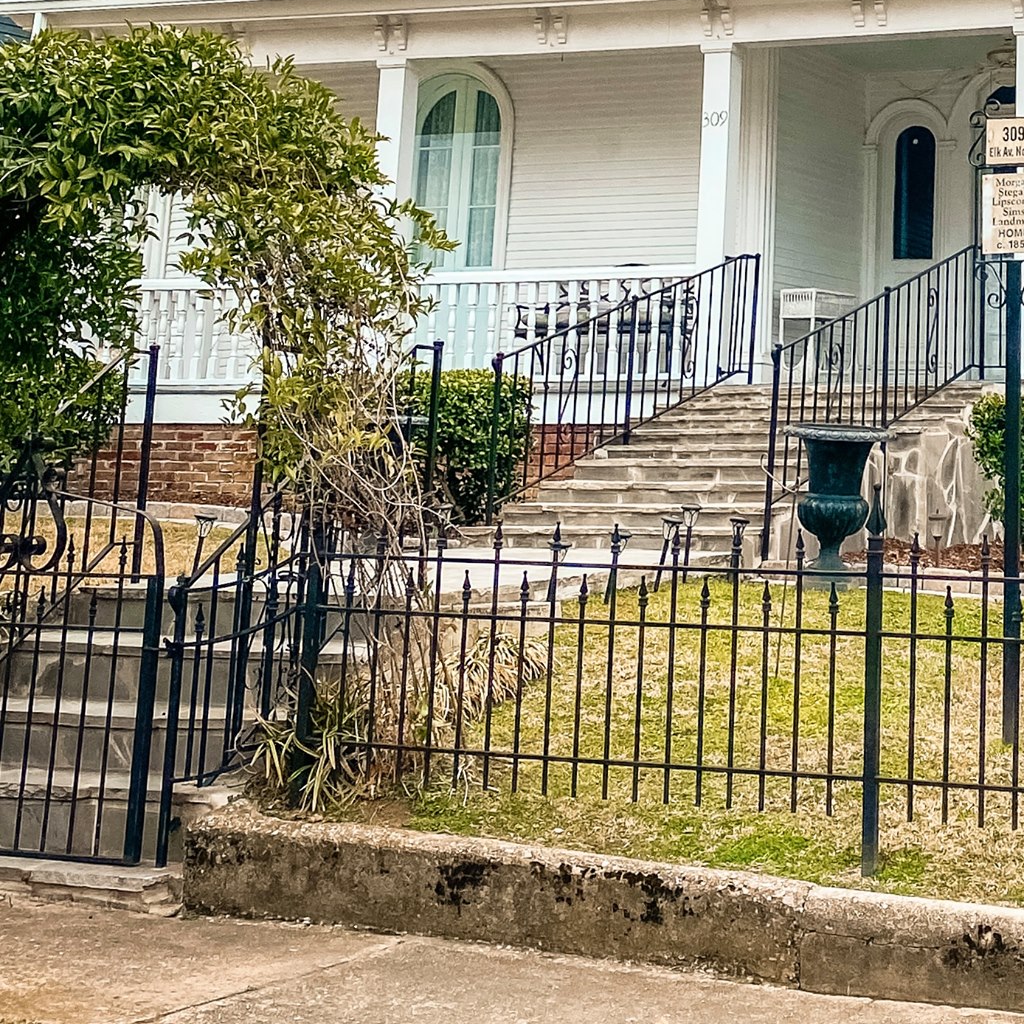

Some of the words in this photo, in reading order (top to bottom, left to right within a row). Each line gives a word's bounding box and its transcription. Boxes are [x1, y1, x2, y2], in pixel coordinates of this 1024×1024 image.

[703, 110, 728, 127] 309
[1002, 126, 1024, 142] 309
[989, 147, 1002, 157] Elk
[1003, 146, 1014, 157] Av.
[1002, 207, 1024, 216] Sims
